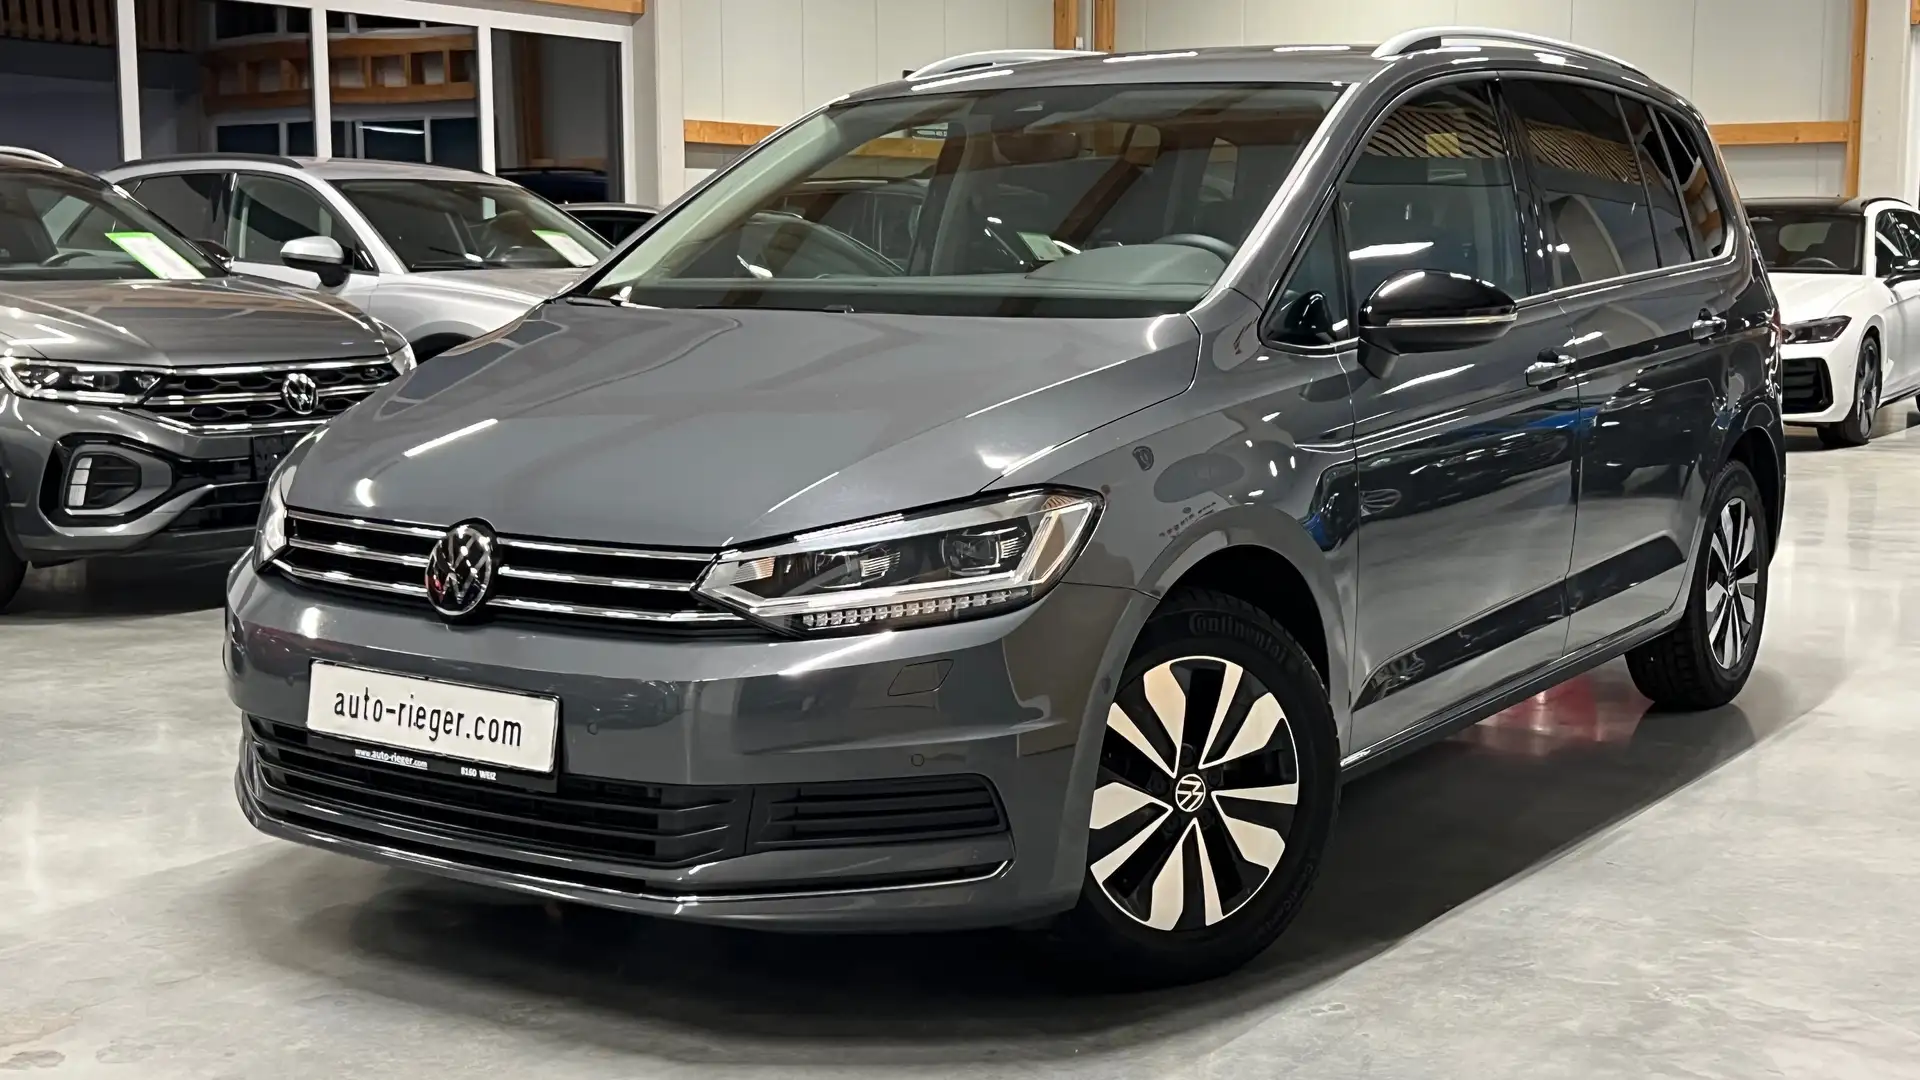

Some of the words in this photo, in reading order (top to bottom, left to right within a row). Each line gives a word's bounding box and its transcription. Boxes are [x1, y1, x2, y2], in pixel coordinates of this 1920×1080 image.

[334, 687, 522, 747] auto-rieger.com
[355, 749, 428, 769] www.auto-rieger.com
[461, 767, 478, 778] 8160
[479, 770, 497, 781] WEIZ
